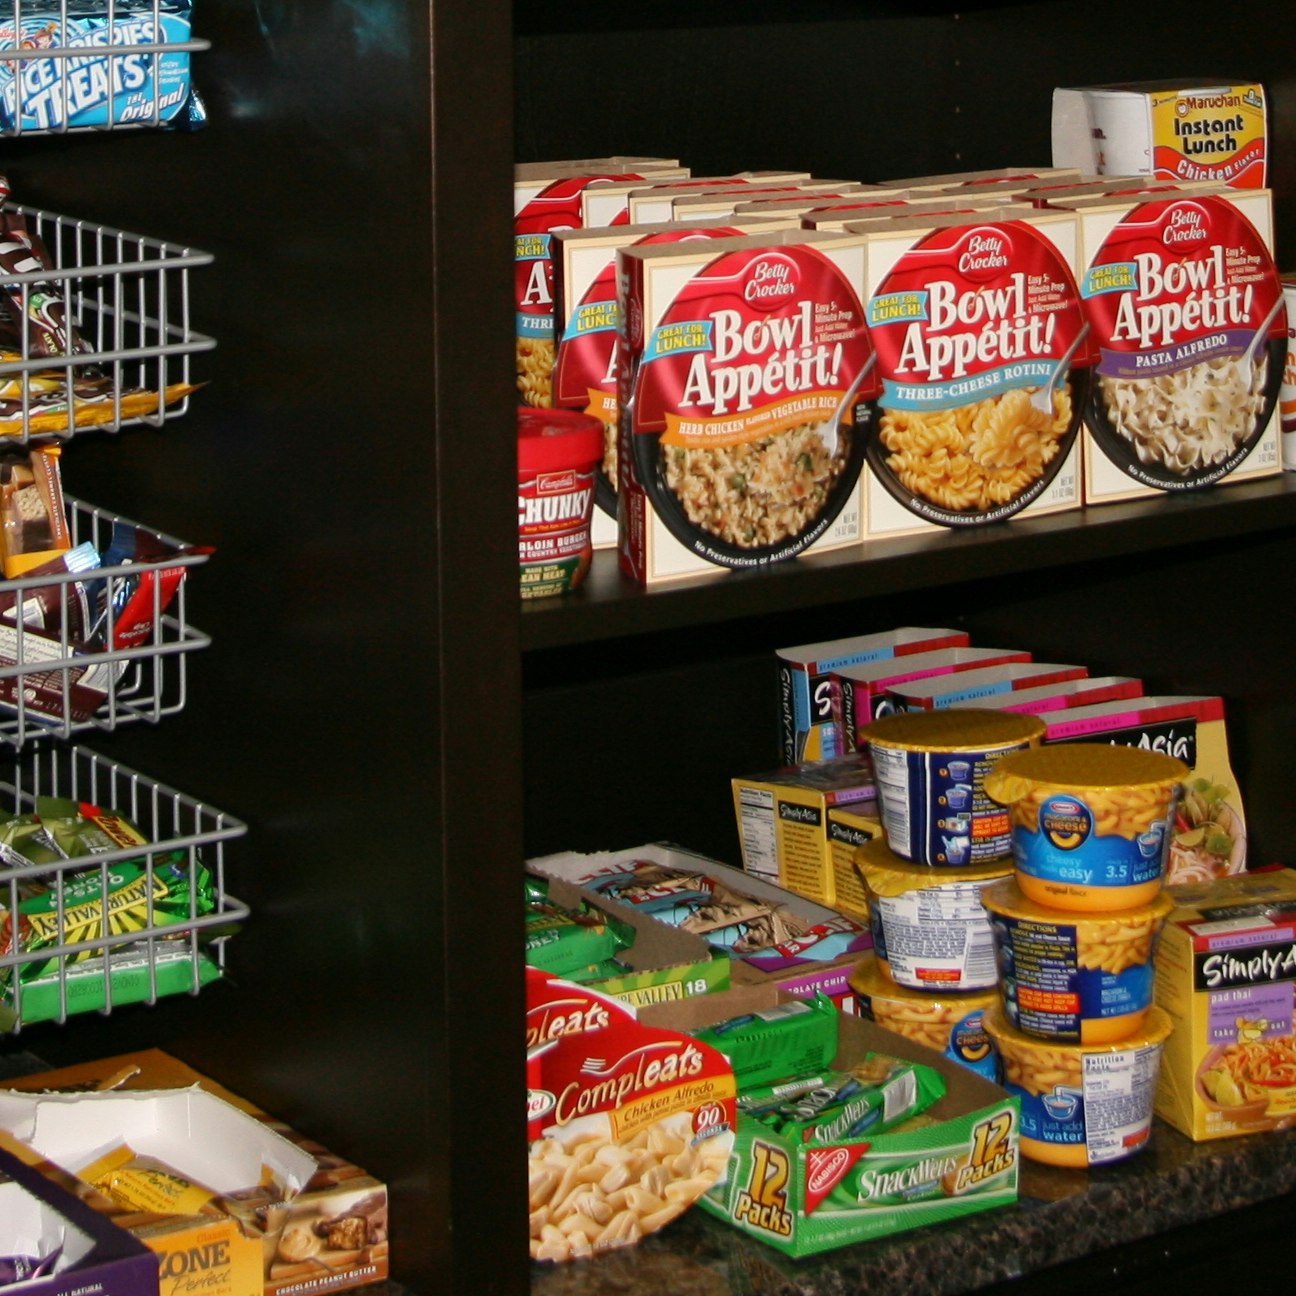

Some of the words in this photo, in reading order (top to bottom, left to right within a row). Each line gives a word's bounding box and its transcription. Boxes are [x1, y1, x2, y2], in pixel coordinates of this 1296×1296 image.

[1185, 93, 1241, 110] Maruchan
[1174, 114, 1244, 136] Instant
[1182, 134, 1237, 155] Lunch
[1170, 208, 1202, 229] Betty
[968, 234, 1002, 256] Betty
[1163, 225, 1208, 246] Crocker
[755, 261, 791, 283] Betty
[958, 252, 1008, 274] Crocker
[1133, 244, 1226, 302] Bowl
[744, 279, 796, 301] Crocker
[1088, 273, 1132, 293] LUNCH!
[872, 302, 922, 324] LUNCH!
[924, 272, 1026, 332] Bowl
[1109, 284, 1253, 349] Appétit!
[655, 332, 706, 354] LUNCH!
[709, 301, 813, 364] Bowl
[894, 312, 1056, 381] Appétit!
[1135, 352, 1173, 369] PASTA
[1176, 333, 1227, 360] ALFREDO
[678, 342, 843, 416] Appétit!
[896, 371, 1001, 401] THREE-CHEESE
[1004, 363, 1052, 380] ROTINI
[679, 421, 703, 434] HERB
[705, 419, 744, 434] CHICKEN
[771, 399, 818, 421] VEGETABLE
[818, 397, 839, 409] RICE
[694, 540, 706, 553] No
[706, 547, 758, 566] Preservatives
[759, 556, 769, 565] or
[770, 540, 804, 563] Artificial
[803, 517, 829, 546] Flavors
[1059, 867, 1094, 885] easy
[1105, 864, 1128, 879] 3.5
[636, 983, 683, 1006] VALLEY
[685, 979, 707, 996] 18
[1211, 991, 1230, 1006] pad
[1231, 989, 1252, 1002] thai
[554, 1041, 704, 1128] Compleats
[623, 1093, 671, 1123] Chicken
[674, 1080, 715, 1102] Alfredo
[696, 1105, 721, 1130] 90
[1062, 1118, 1084, 1132] add
[971, 1111, 1014, 1168] 12
[1042, 1130, 1083, 1143] water
[748, 1141, 791, 1214] 12
[811, 1151, 848, 1190] NABISCO
[956, 1148, 1015, 1191] Packs
[734, 1191, 793, 1237] Packs
[275, 1279, 318, 1296] CHOCOLATE
[318, 1272, 349, 1288] PEANUT
[349, 1264, 378, 1281] BUTTER
